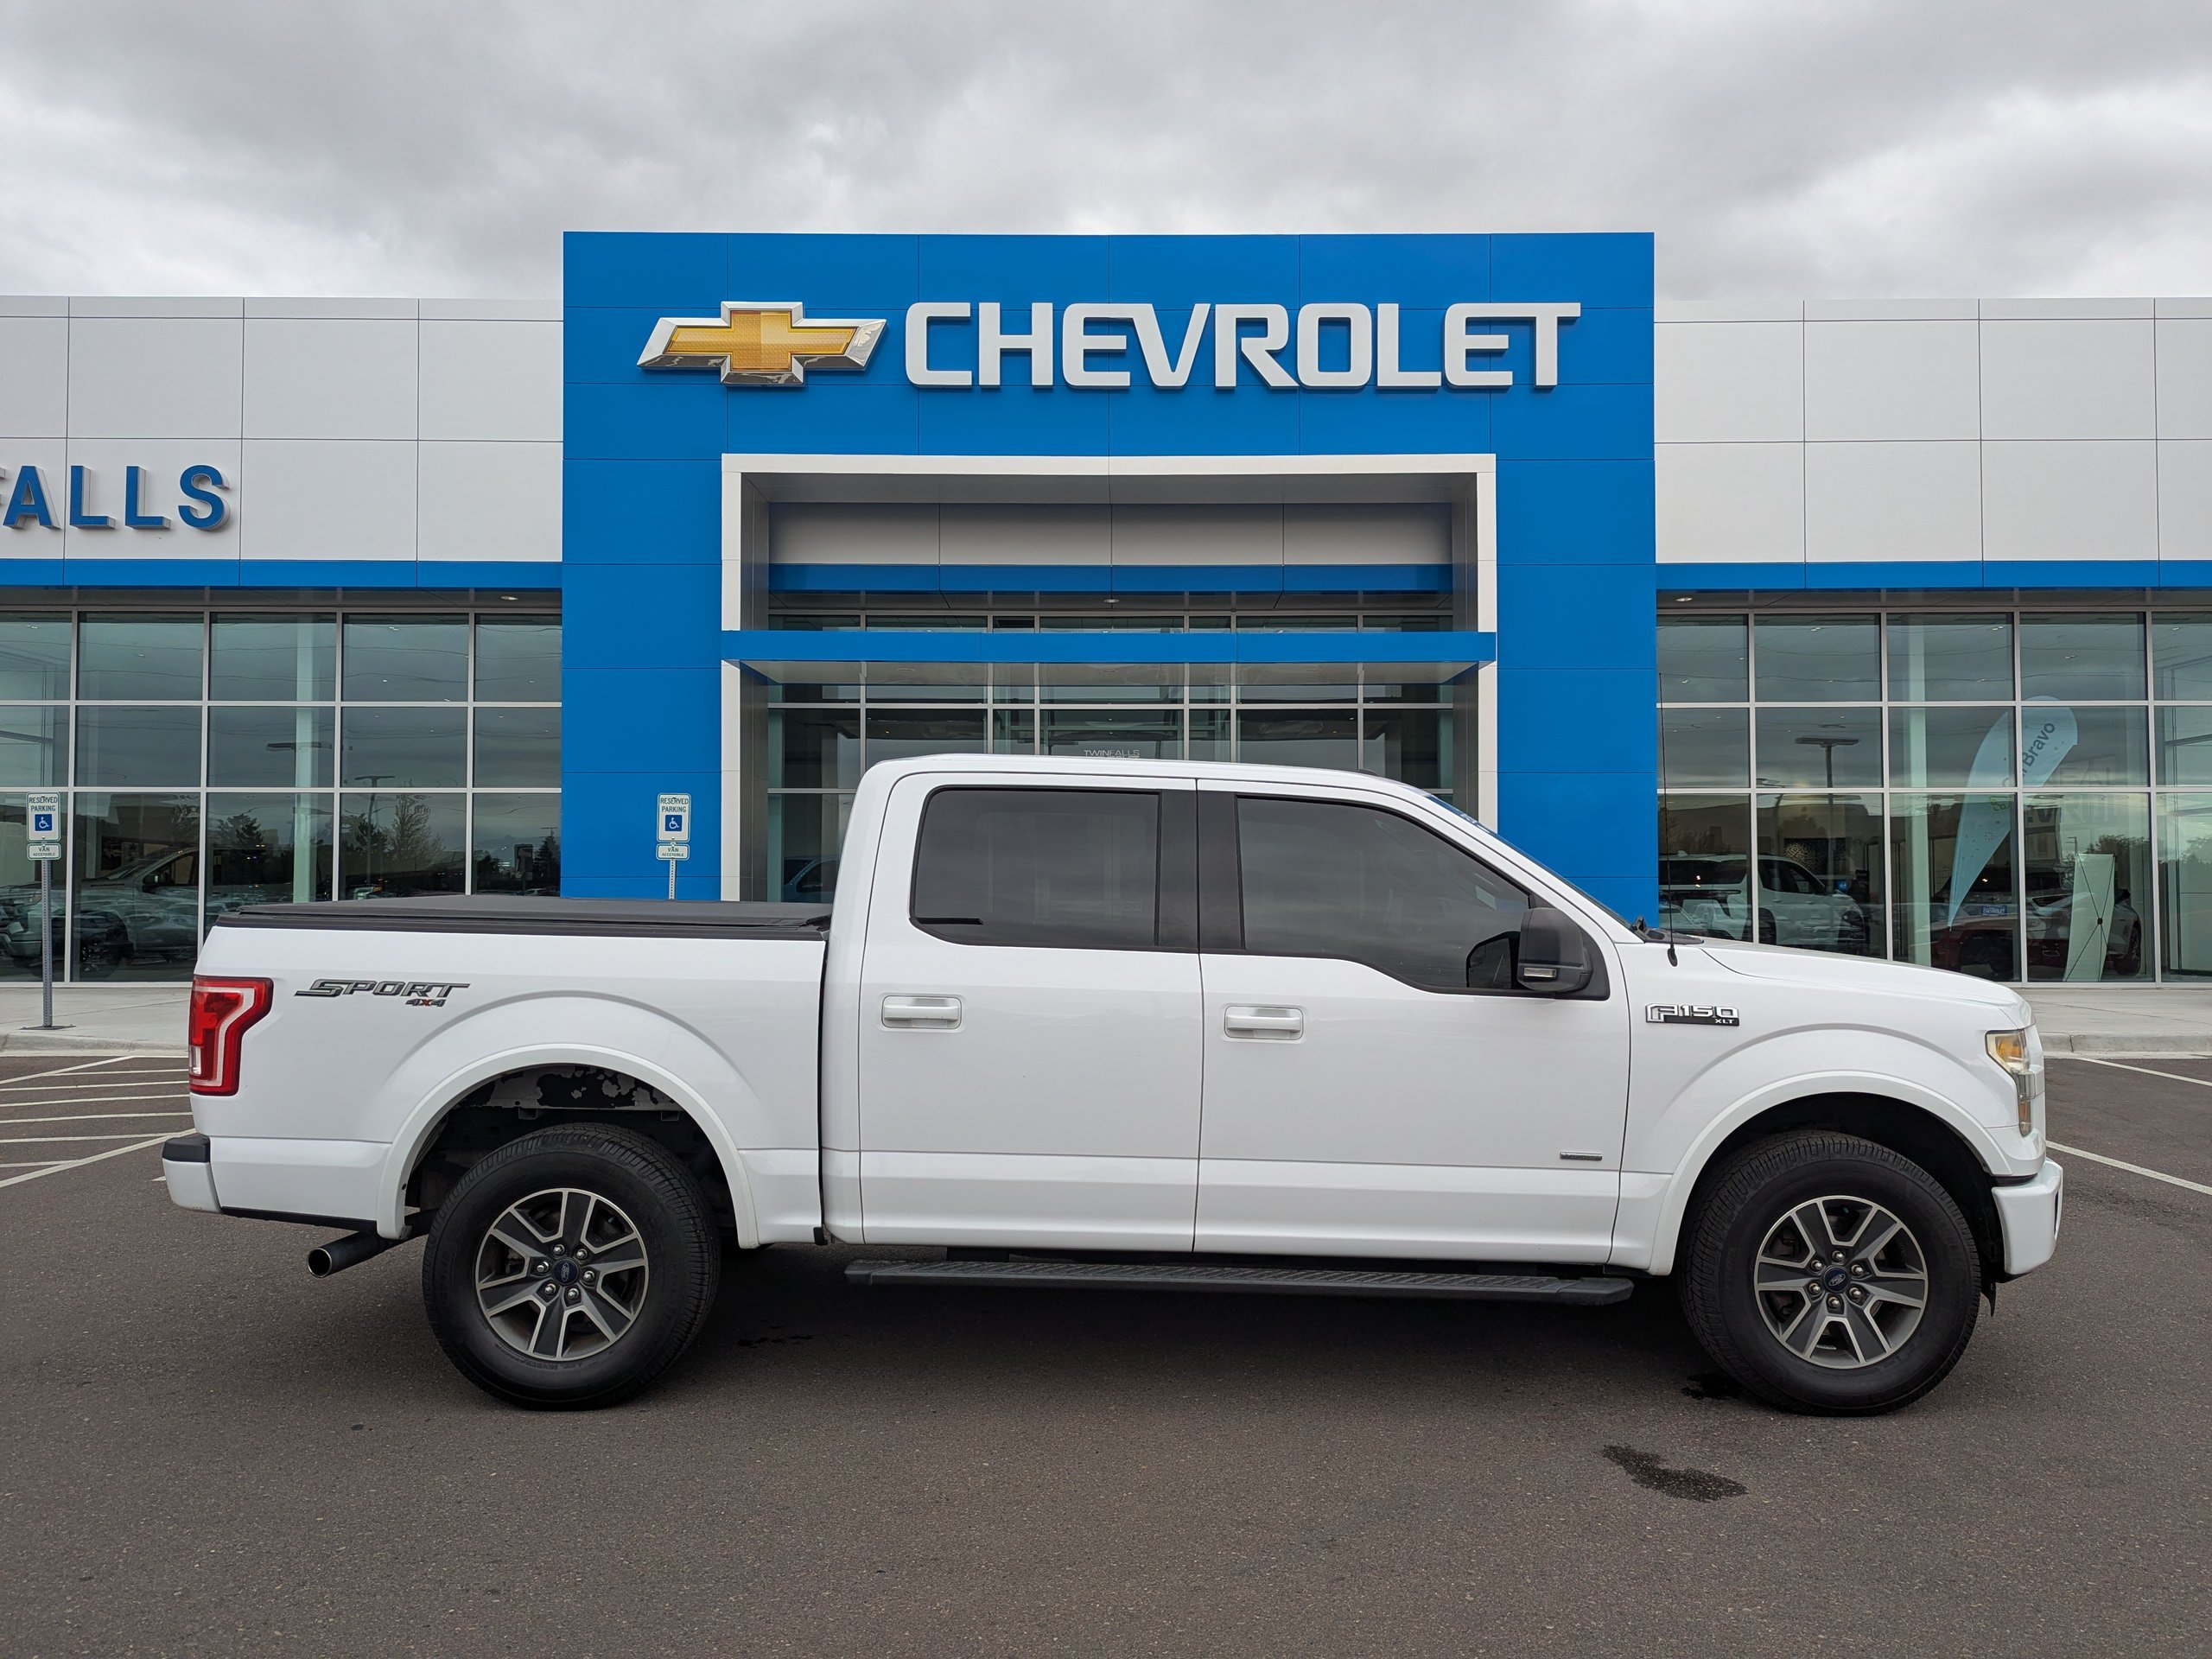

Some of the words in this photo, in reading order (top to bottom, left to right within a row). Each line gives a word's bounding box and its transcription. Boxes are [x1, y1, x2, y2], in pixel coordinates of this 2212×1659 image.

[905, 302, 1581, 391] CHEVROLET
[0, 464, 231, 531] ALLS
[294, 979, 471, 998] SPORT
